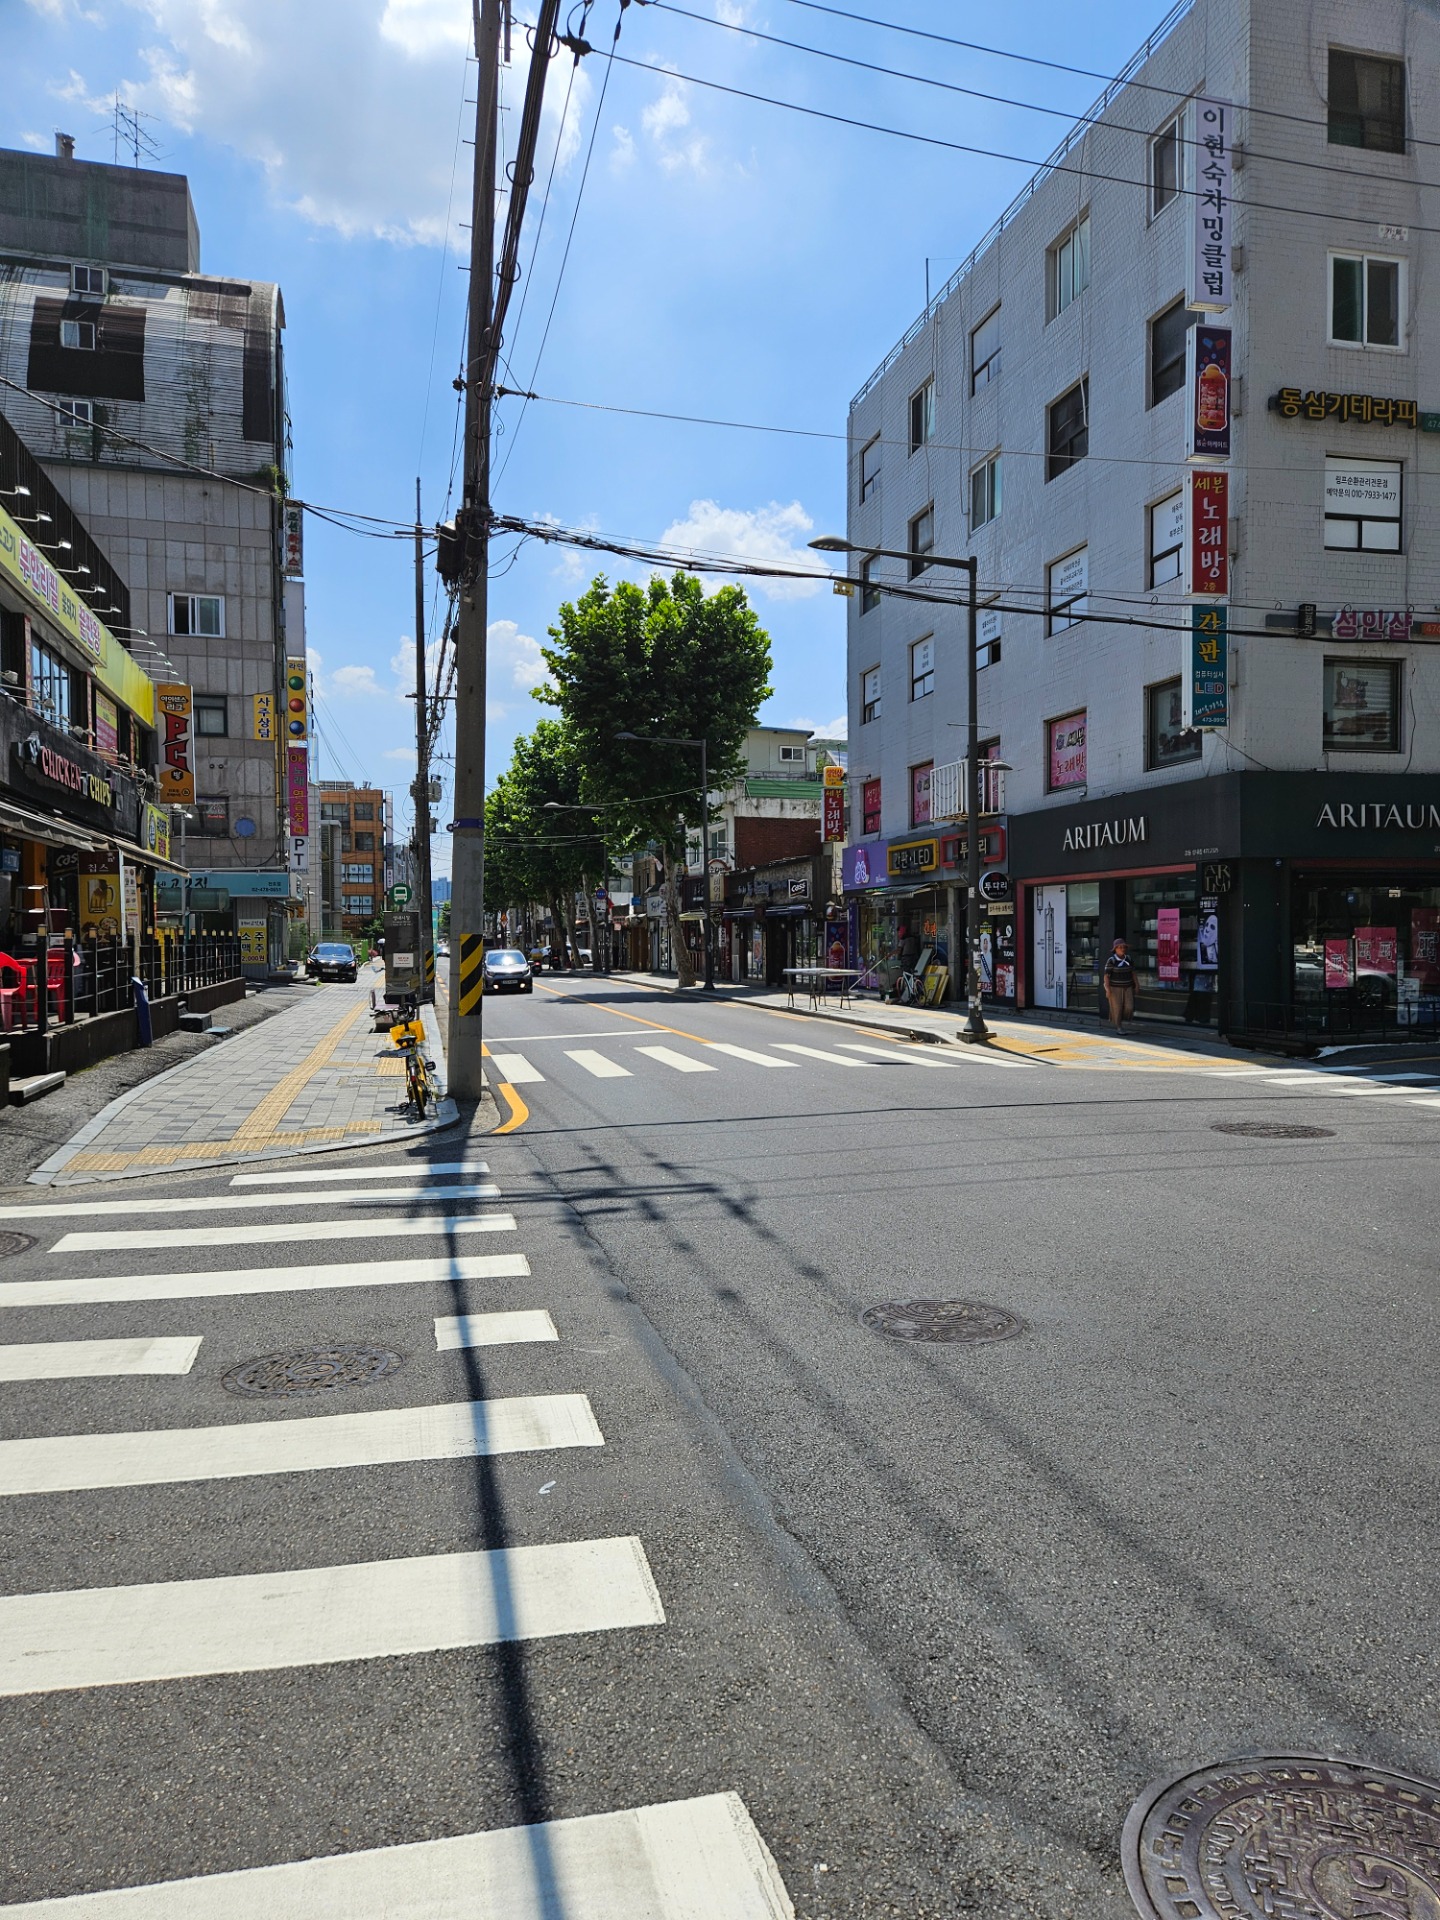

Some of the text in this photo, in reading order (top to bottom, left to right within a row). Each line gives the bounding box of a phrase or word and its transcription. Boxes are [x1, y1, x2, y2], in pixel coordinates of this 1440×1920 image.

[1201, 107, 1226, 296] 이현숙차밍클럽
[1280, 388, 1417, 428] 동심기테라피
[1194, 476, 1225, 494] 세븐
[1351, 489, 1397, 501] 010-7933-1477
[1199, 496, 1224, 578] 노래방
[19, 536, 60, 615] 무한리필
[1203, 581, 1217, 591] 2층
[1199, 611, 1222, 663] 간판
[1332, 609, 1414, 640] 성인샵
[288, 662, 305, 672] 라인
[1195, 682, 1225, 694] LED
[257, 696, 272, 738] 사주상담
[162, 712, 190, 774] PC
[289, 753, 305, 764] OK
[1056, 752, 1086, 775] 노래방
[42, 745, 81, 791] CHICKEN
[89, 773, 112, 808] CHIPS
[291, 764, 305, 823] 노래연습장
[826, 797, 842, 833] 노래방
[1062, 816, 1146, 851] ARITAUM
[294, 839, 305, 866] PT
[913, 848, 930, 865] LED
[960, 837, 987, 859] 투리
[89, 864, 110, 873] 칩스
[984, 881, 1007, 891] 투다리
[242, 931, 265, 942] 소주
[242, 943, 265, 953] 맥주
